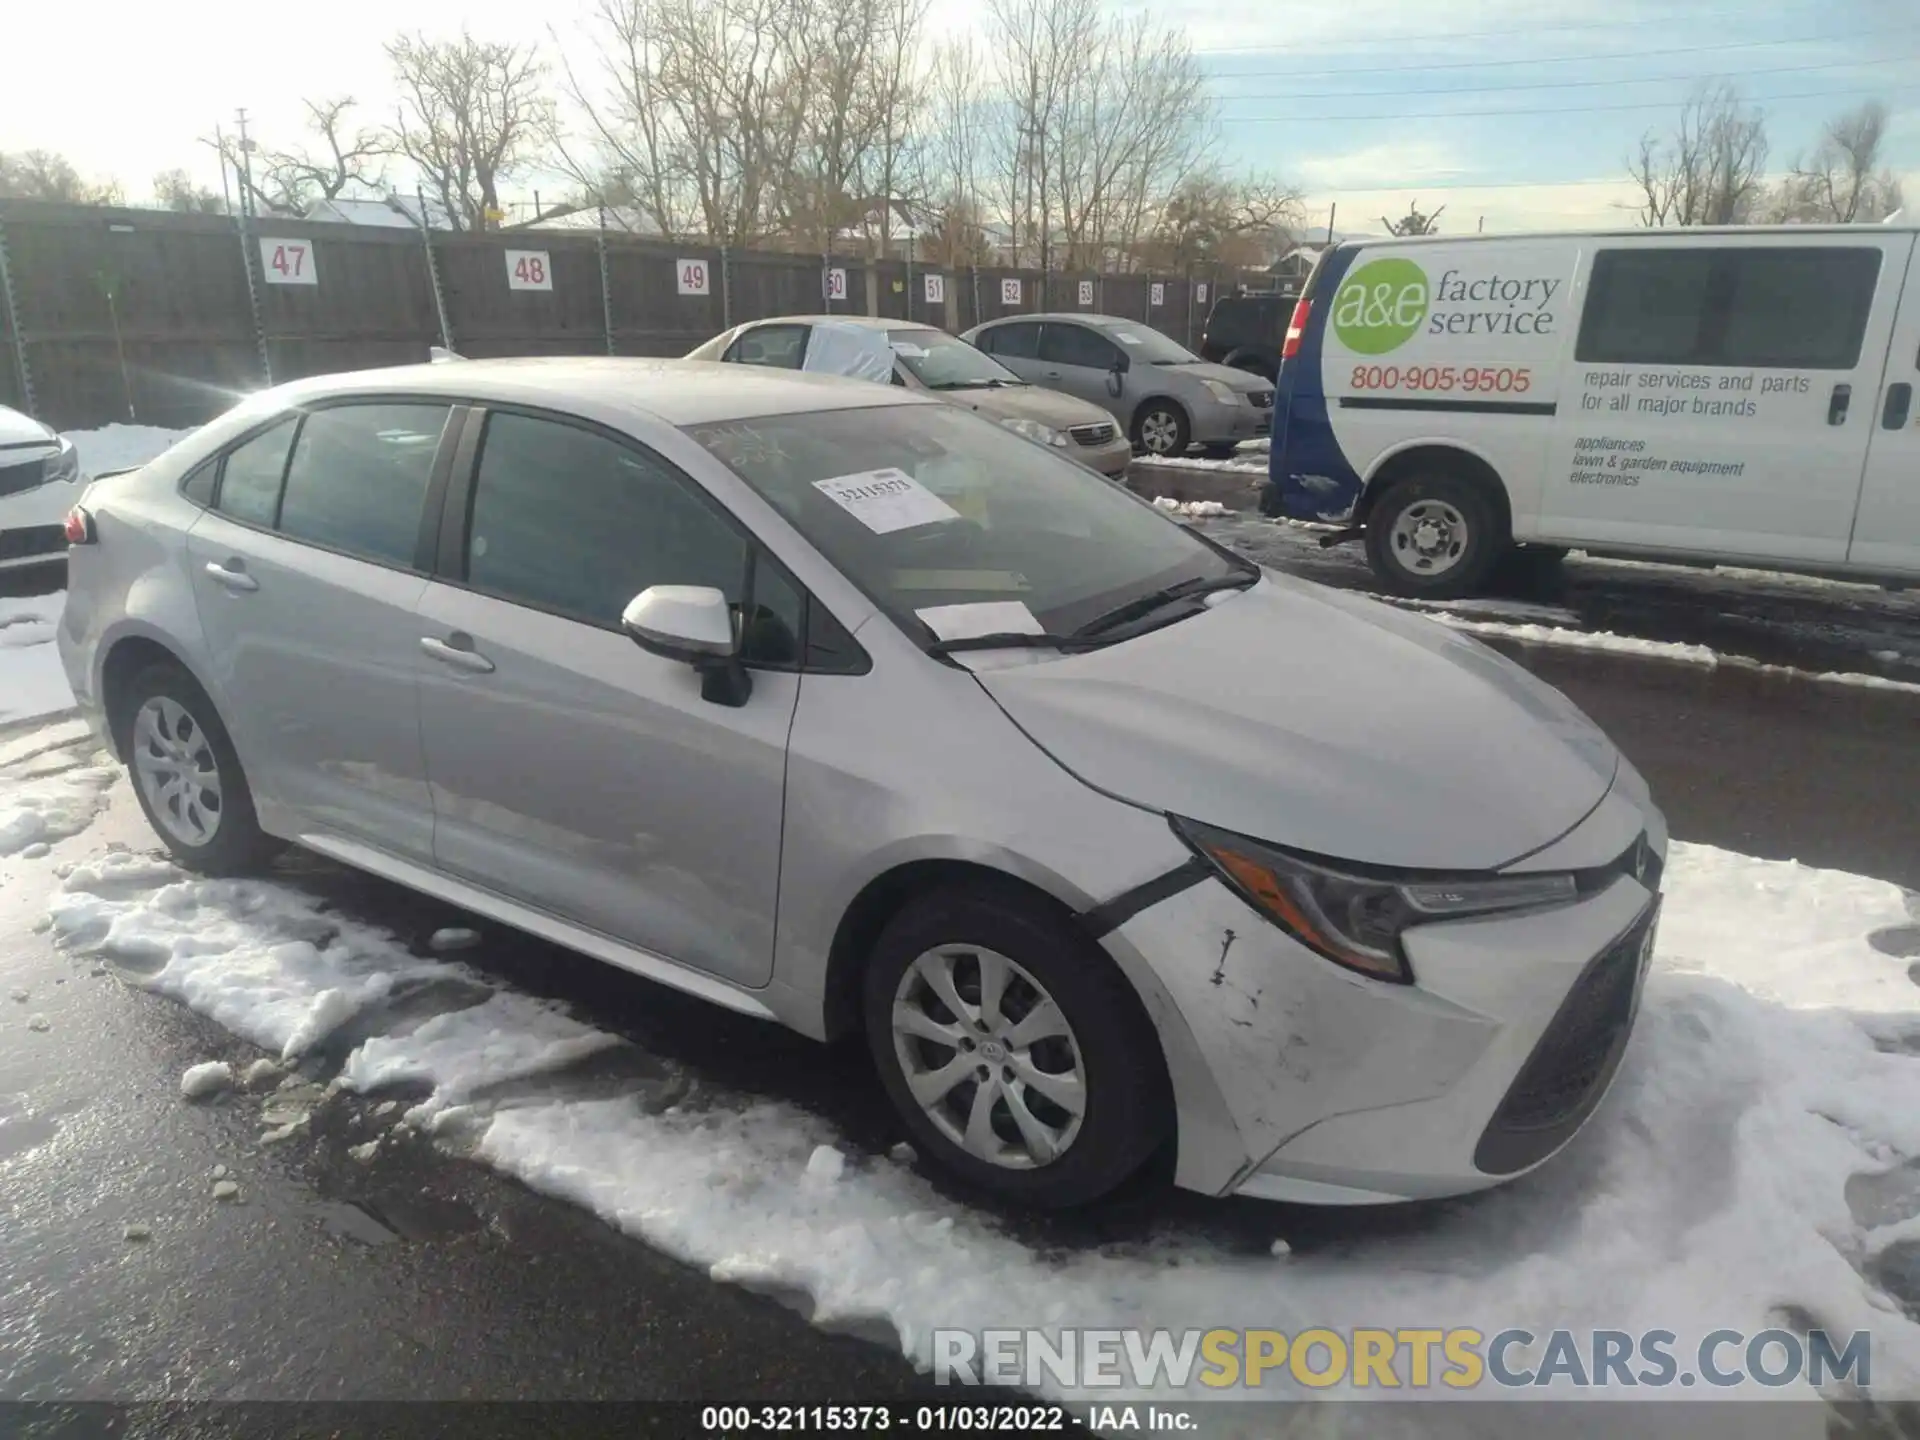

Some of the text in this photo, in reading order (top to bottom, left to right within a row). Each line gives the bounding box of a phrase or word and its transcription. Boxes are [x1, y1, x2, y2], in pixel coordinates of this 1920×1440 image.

[272, 245, 306, 276] 47
[515, 257, 545, 284] 48
[682, 265, 704, 289] 49
[1005, 282, 1020, 301] 52
[1436, 270, 1561, 310] factory
[1336, 282, 1426, 328] a&e
[1428, 304, 1554, 335] service
[1584, 370, 1811, 394] repair services and parts
[1581, 392, 1757, 417] for all major brands
[1574, 435, 1646, 452] appliances
[1572, 453, 1745, 476] lawn & garden equipment
[837, 479, 911, 501] 32115373
[1570, 470, 1640, 486] electronics
